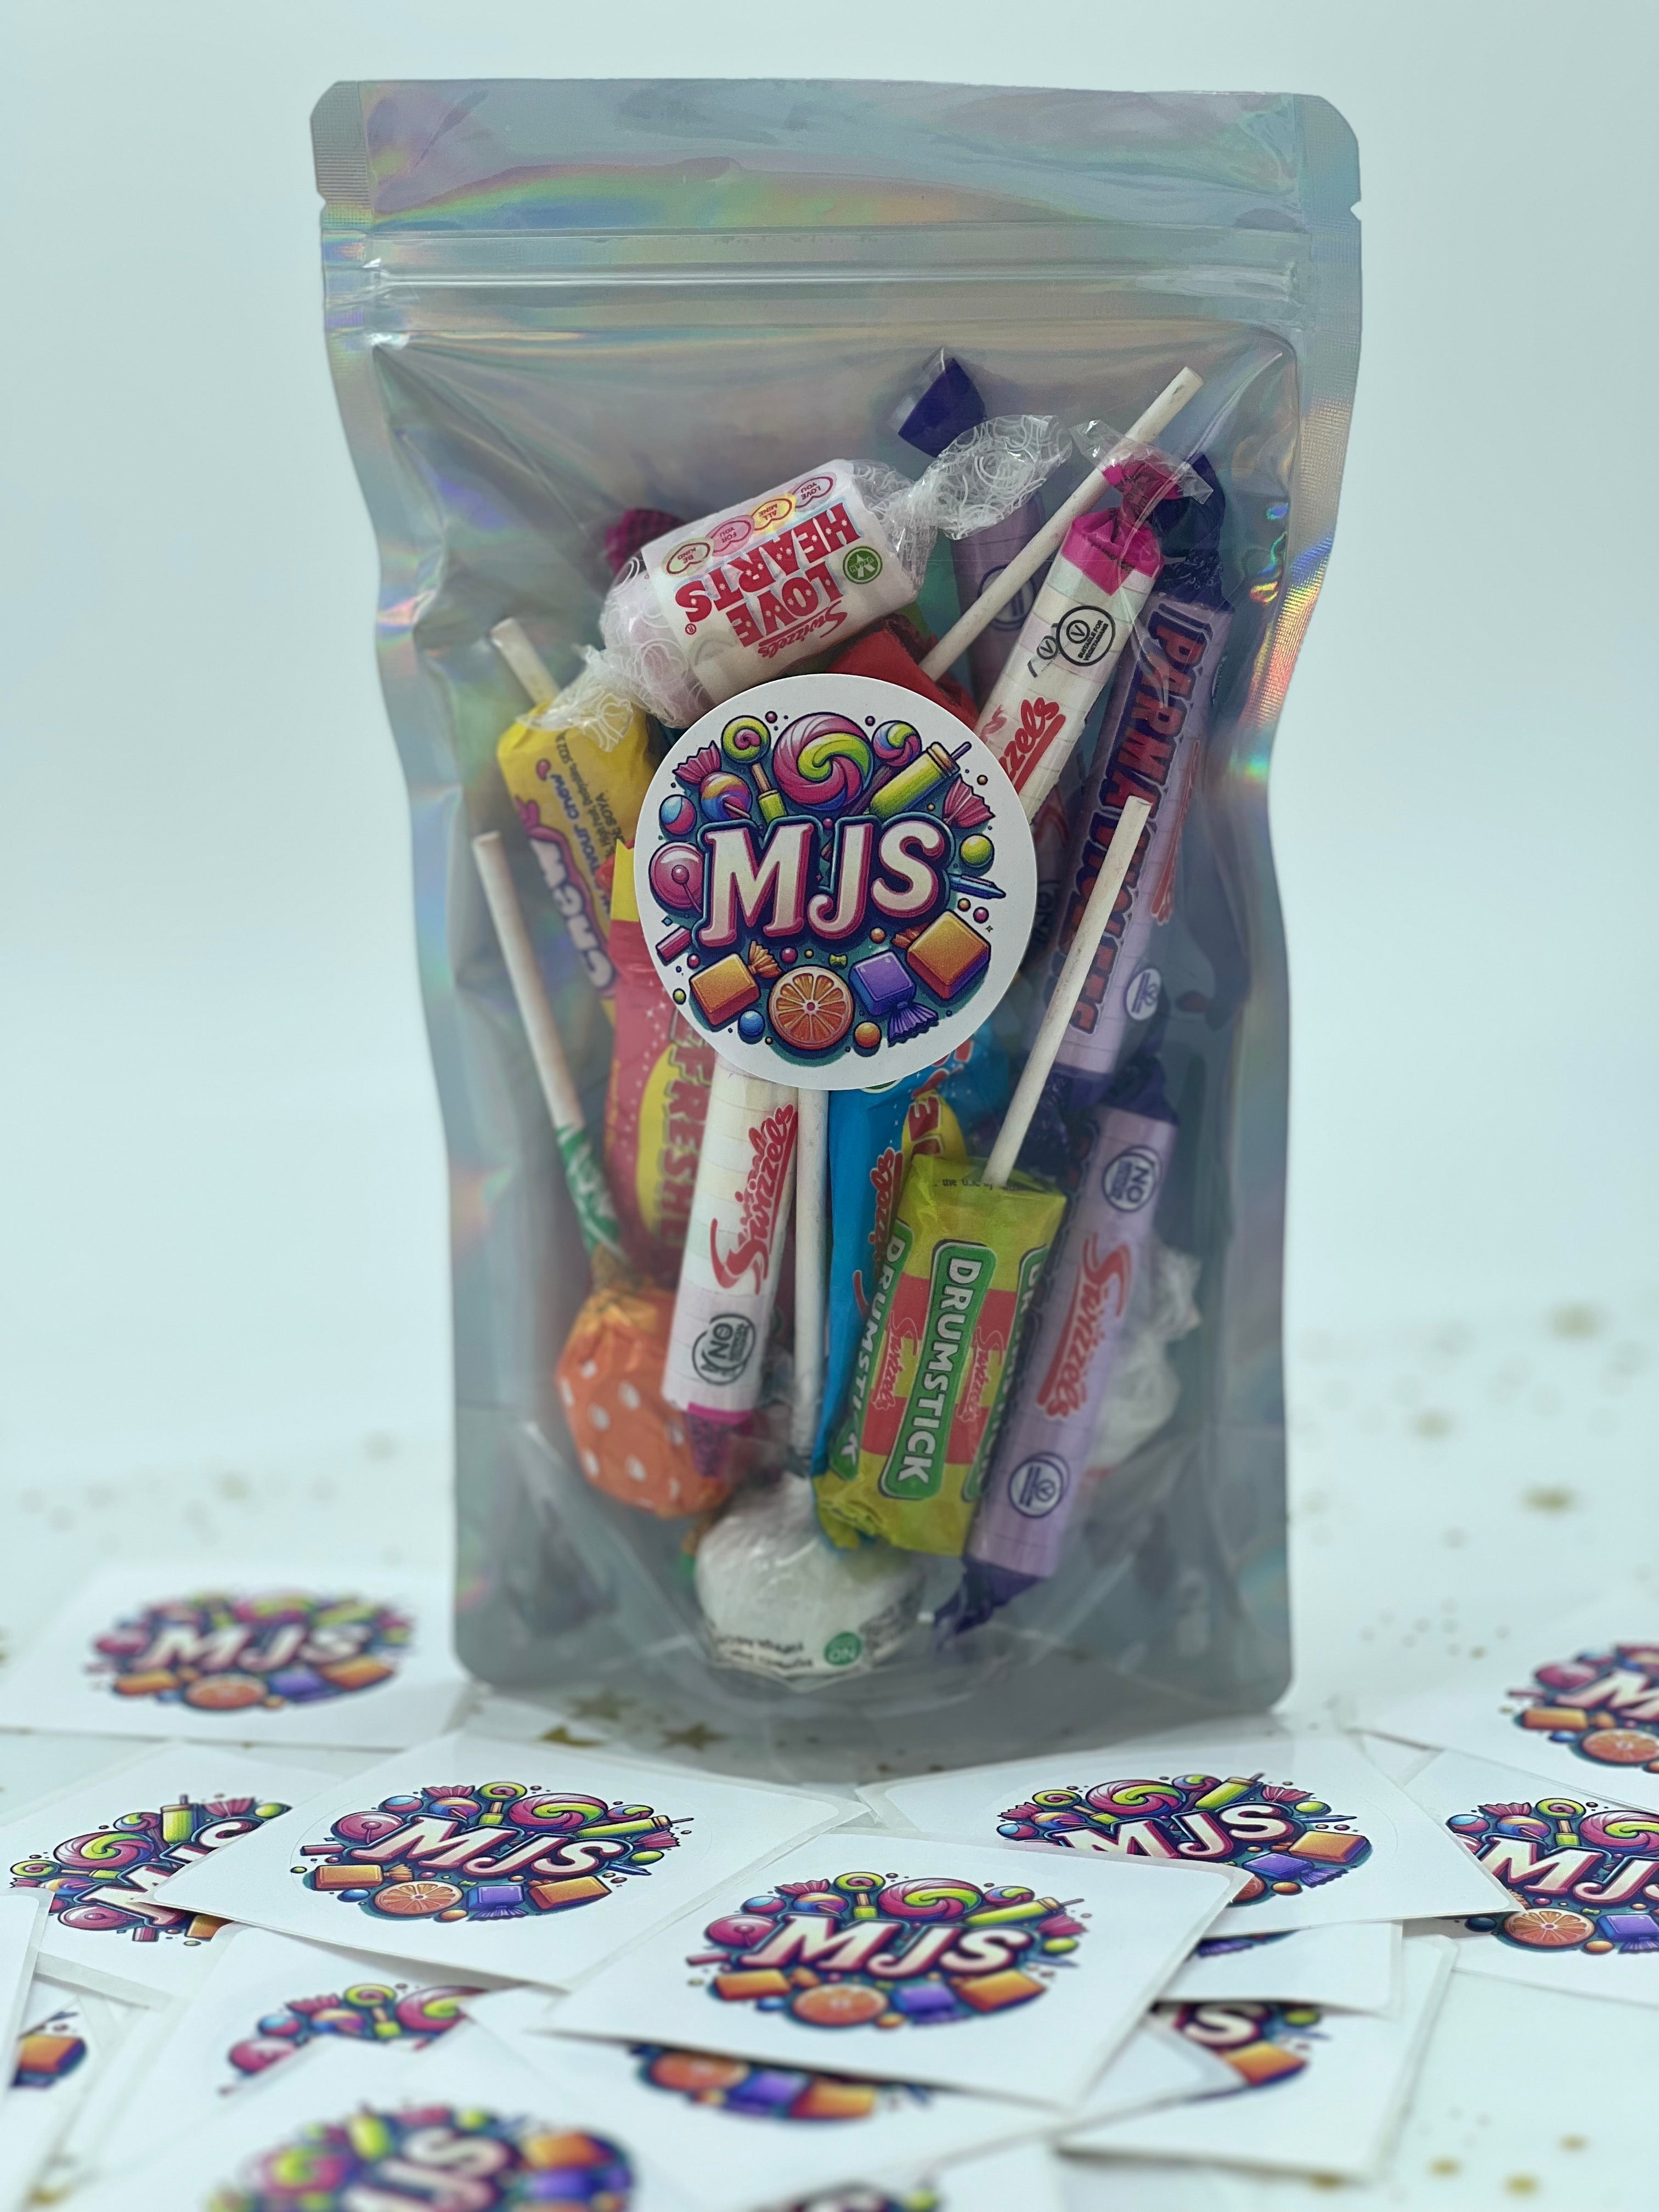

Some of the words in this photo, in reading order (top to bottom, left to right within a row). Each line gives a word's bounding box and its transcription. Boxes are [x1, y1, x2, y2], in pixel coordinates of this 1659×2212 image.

[720, 530, 738, 543] FOR
[757, 502, 780, 517] MINE
[761, 509, 778, 521] ALL
[725, 560, 844, 647] LOVE
[758, 600, 848, 658] Swizzels
[1077, 631, 1096, 659] SUITABLE
[1092, 619, 1103, 633] FOR
[1000, 697, 1066, 793] zzels
[1101, 614, 1210, 817] PARMA
[699, 821, 945, 947] MJS
[710, 1104, 799, 1295] Swizzels
[1127, 1164, 1151, 1204] NO
[842, 1235, 904, 1466] DRUMSTIK
[1038, 1237, 1131, 1420] Swizzels
[898, 1257, 983, 1485] DRUMSTICK
[133, 1625, 370, 1671] MJS
[352, 1816, 624, 1876] MJS
[1060, 1803, 1291, 1859] MJS
[1489, 1836, 1659, 1904] MJ
[742, 1916, 1030, 1975] MJS
